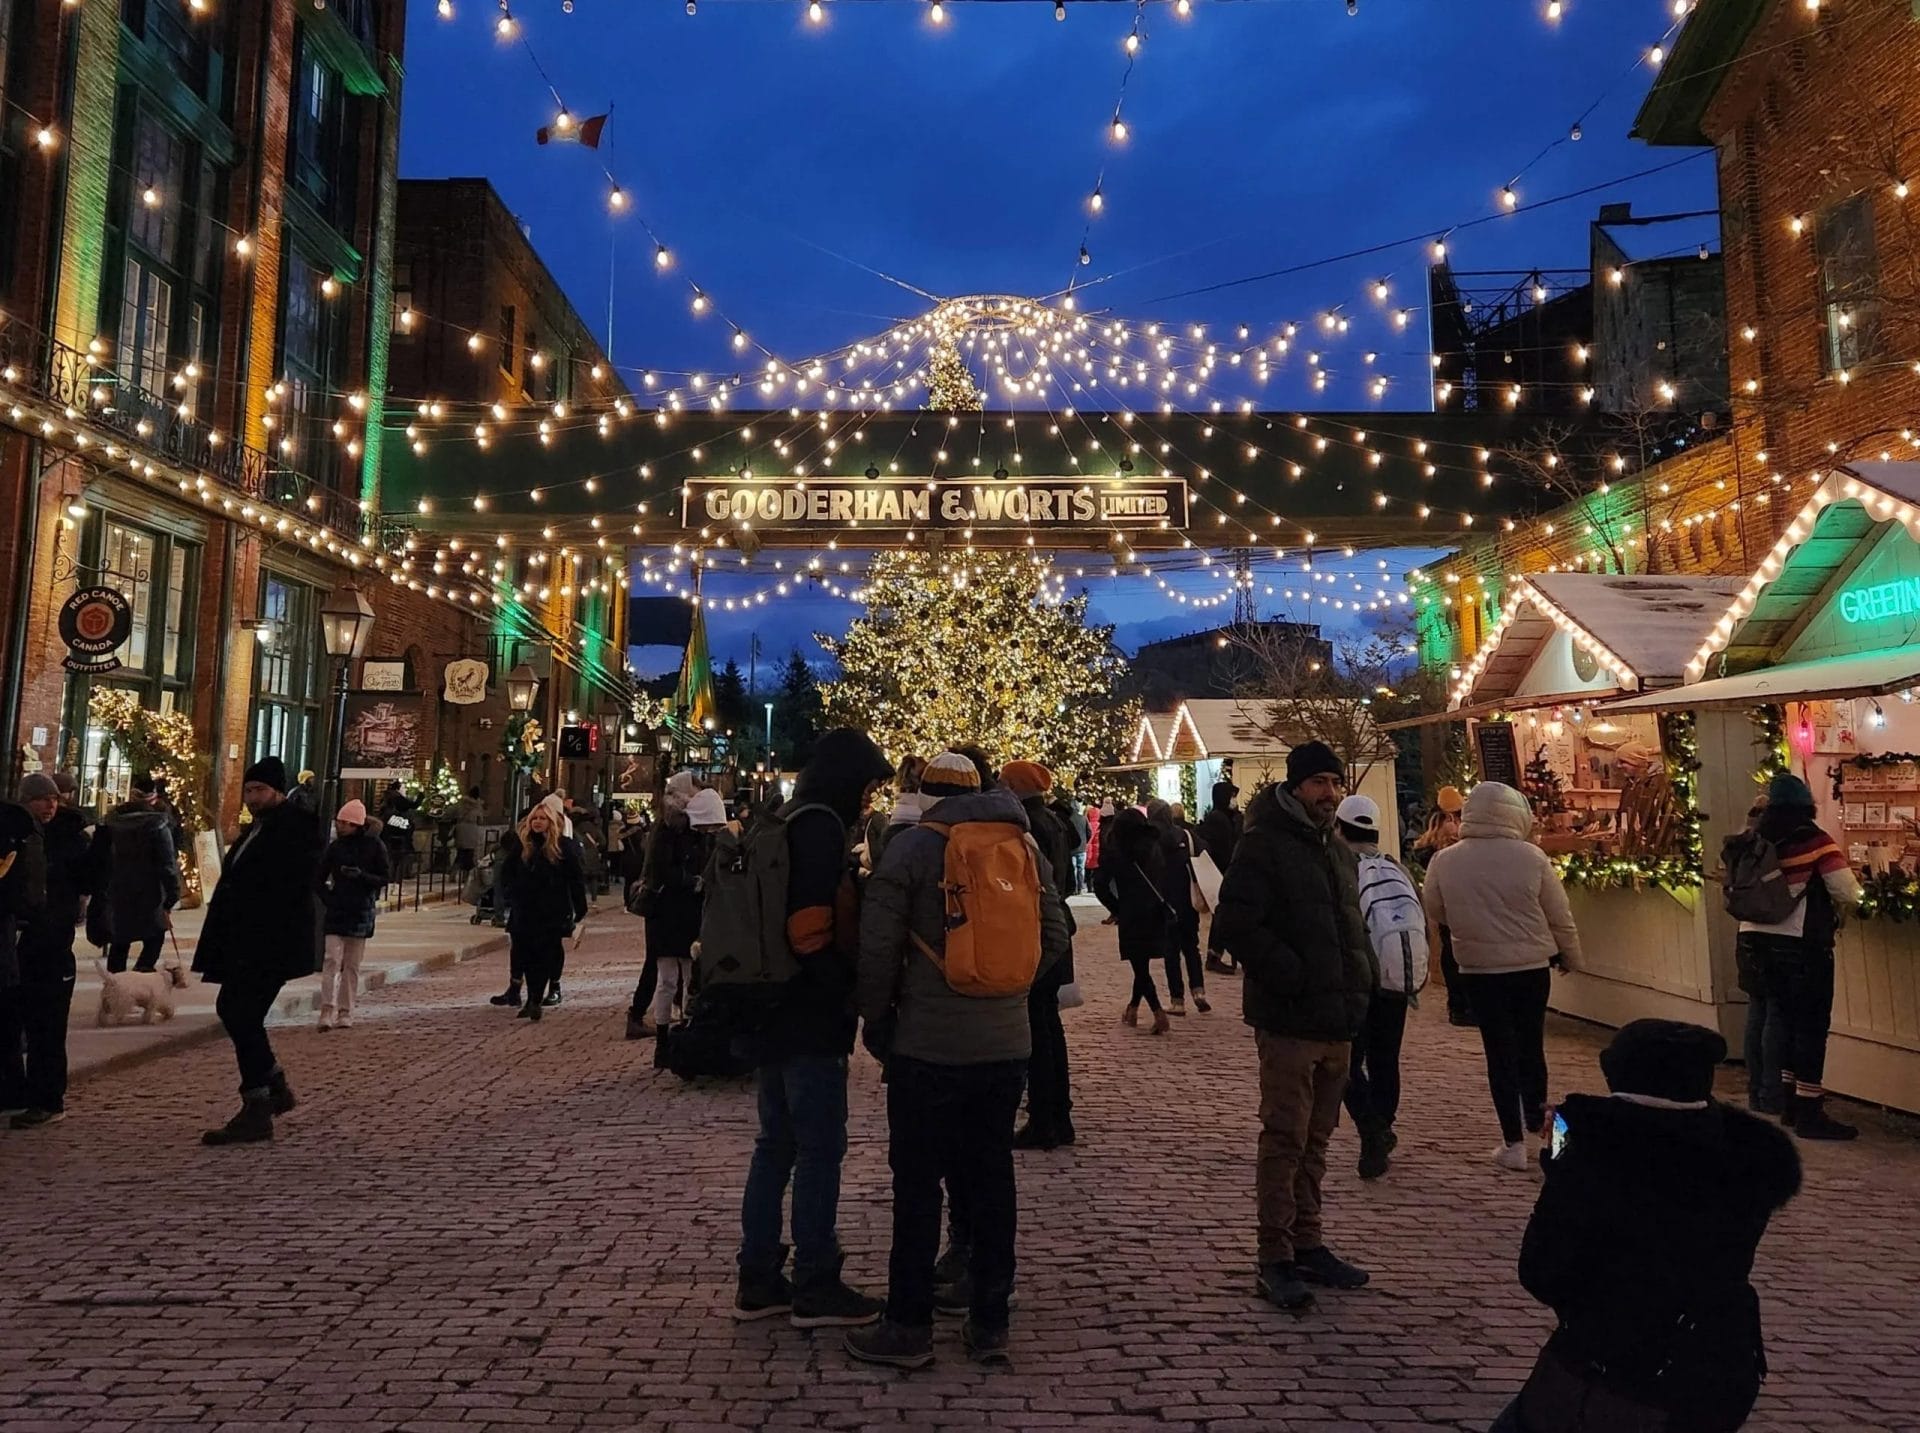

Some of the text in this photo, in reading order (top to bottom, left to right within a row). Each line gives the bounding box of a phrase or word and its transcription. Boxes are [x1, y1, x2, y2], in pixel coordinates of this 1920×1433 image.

[705, 488, 1168, 521] GOODERHAM & WORTS LIMITED
[69, 590, 125, 611] RED CANOE
[72, 638, 113, 651] CANADA
[67, 660, 116, 671] OUTFITTER
